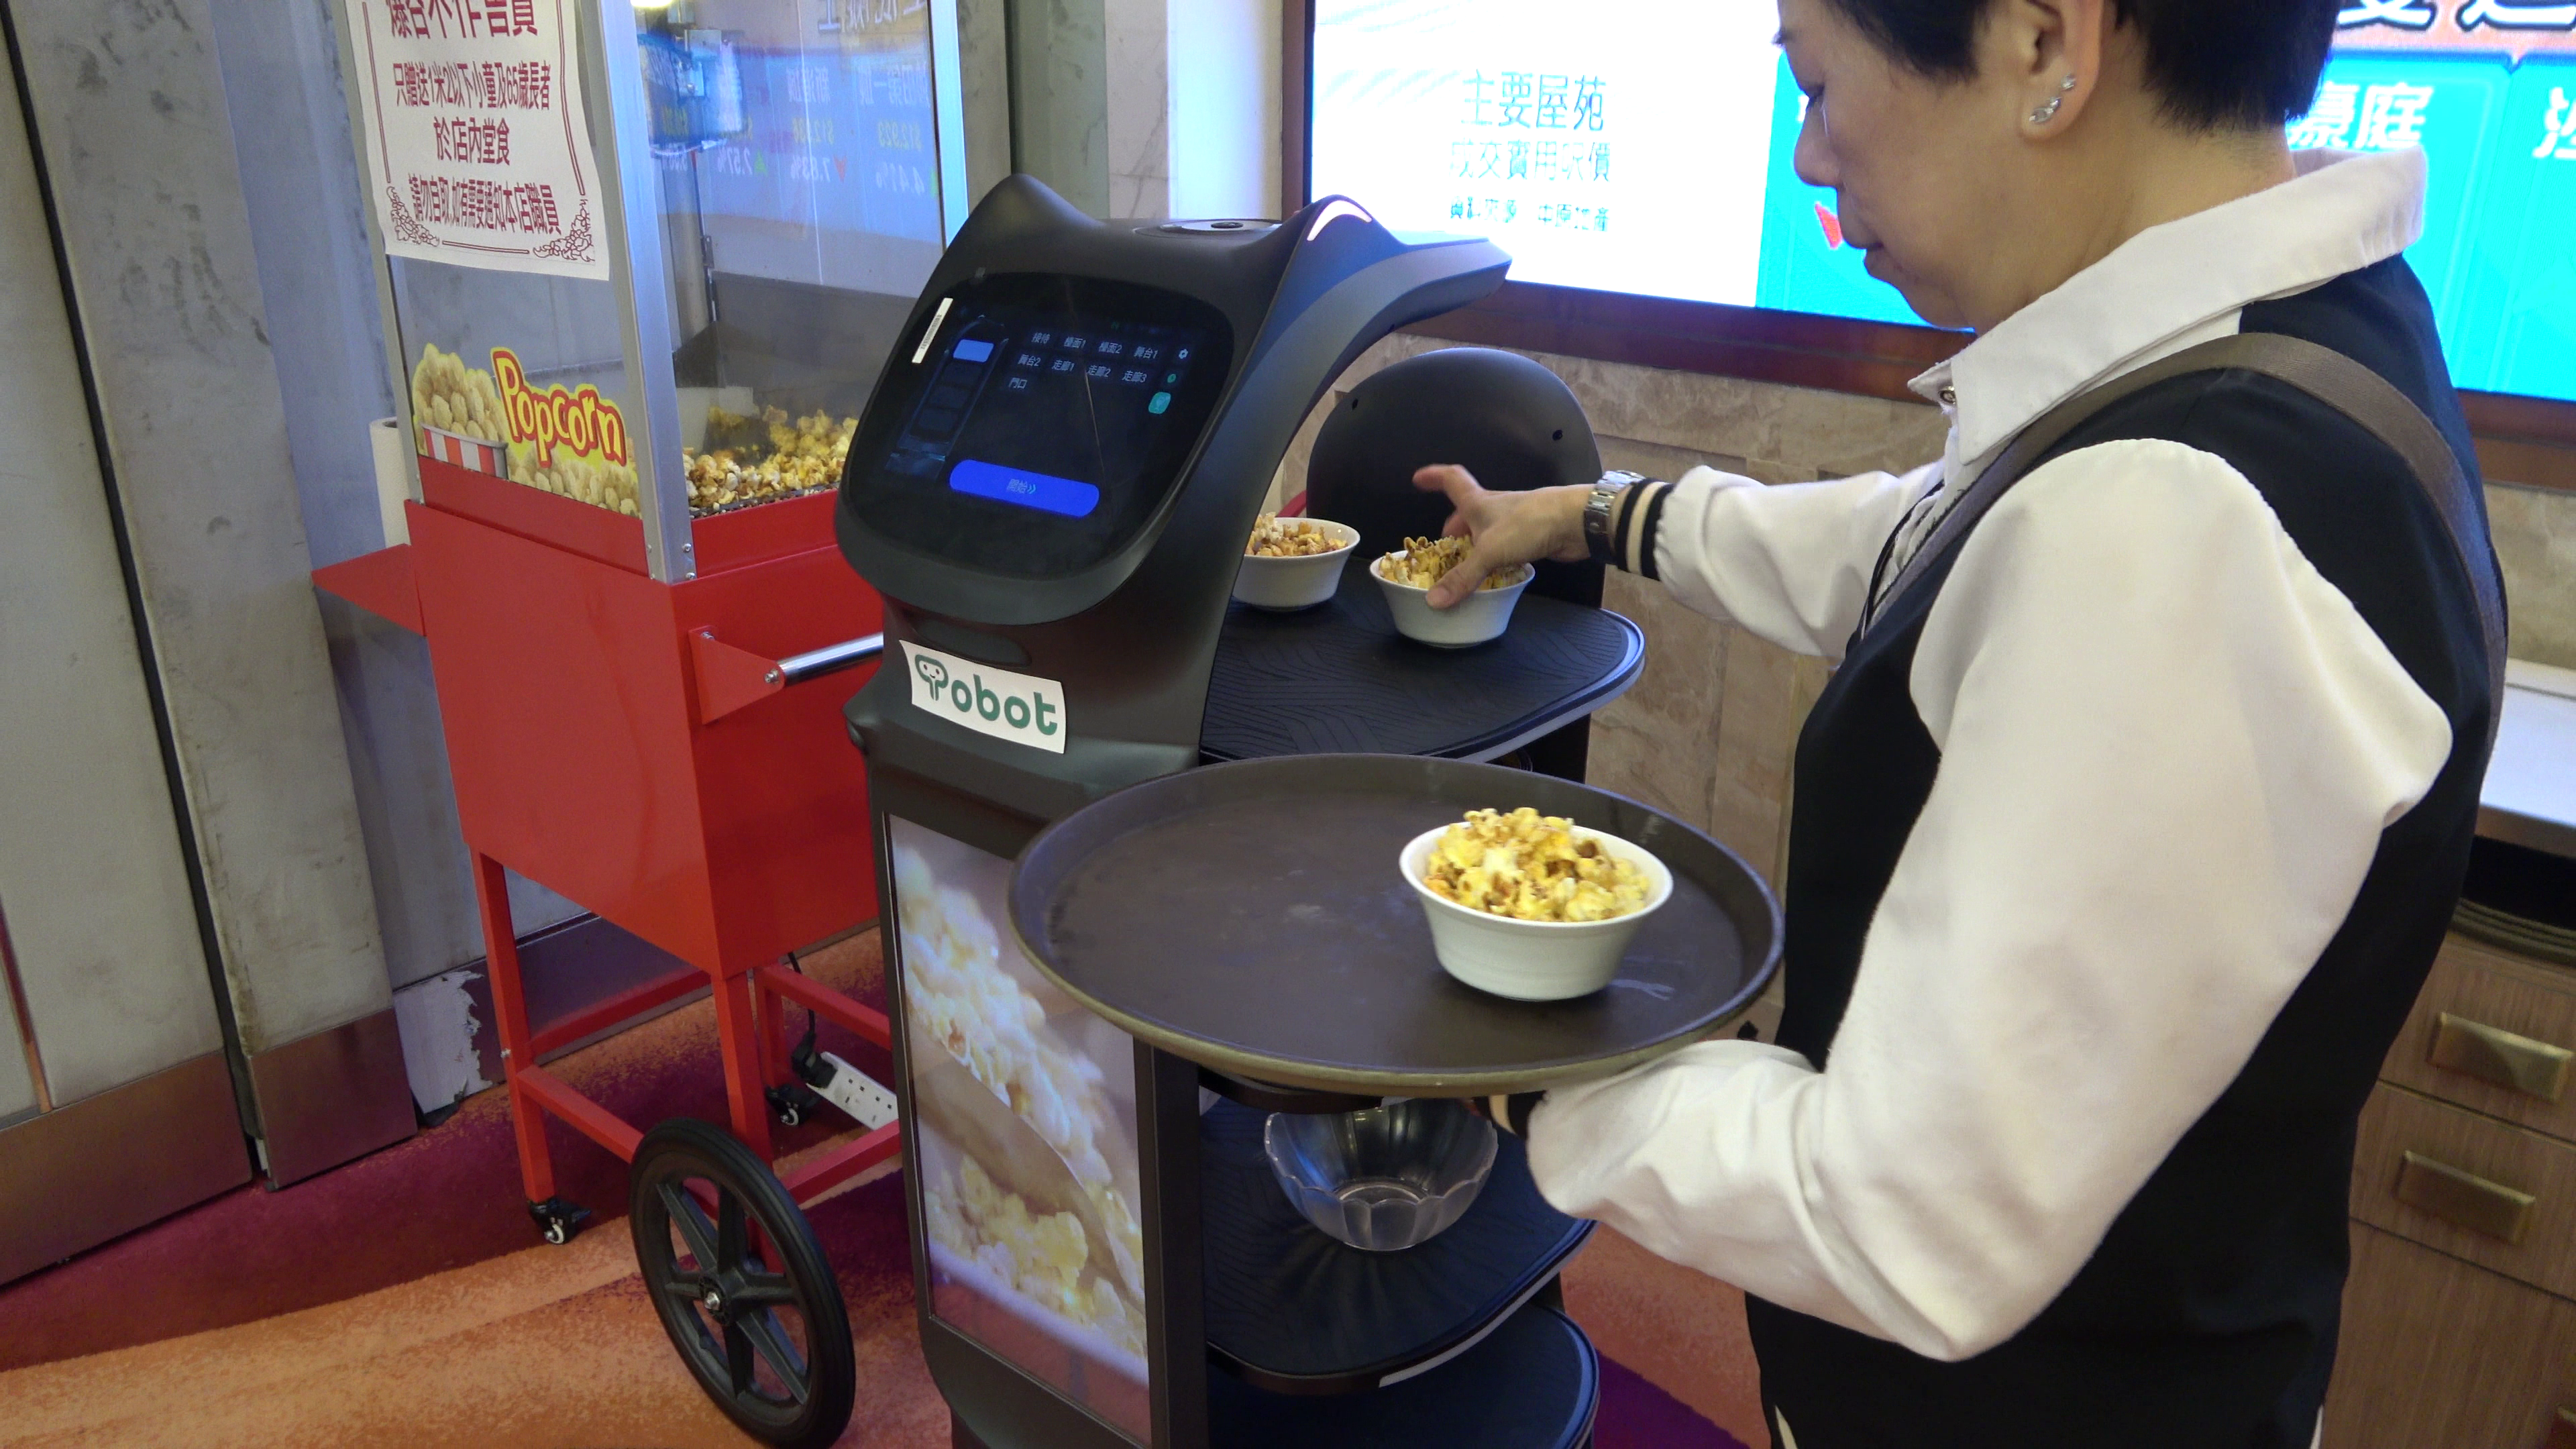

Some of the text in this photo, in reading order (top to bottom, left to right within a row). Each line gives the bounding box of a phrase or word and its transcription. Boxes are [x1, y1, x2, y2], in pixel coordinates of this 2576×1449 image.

[392, 60, 551, 110] 只贈送1米2以下小童及65歲長者
[1460, 68, 1607, 131] 主要屋苑
[433, 116, 511, 166] 於店內堂食
[493, 350, 627, 468] Popcorn
